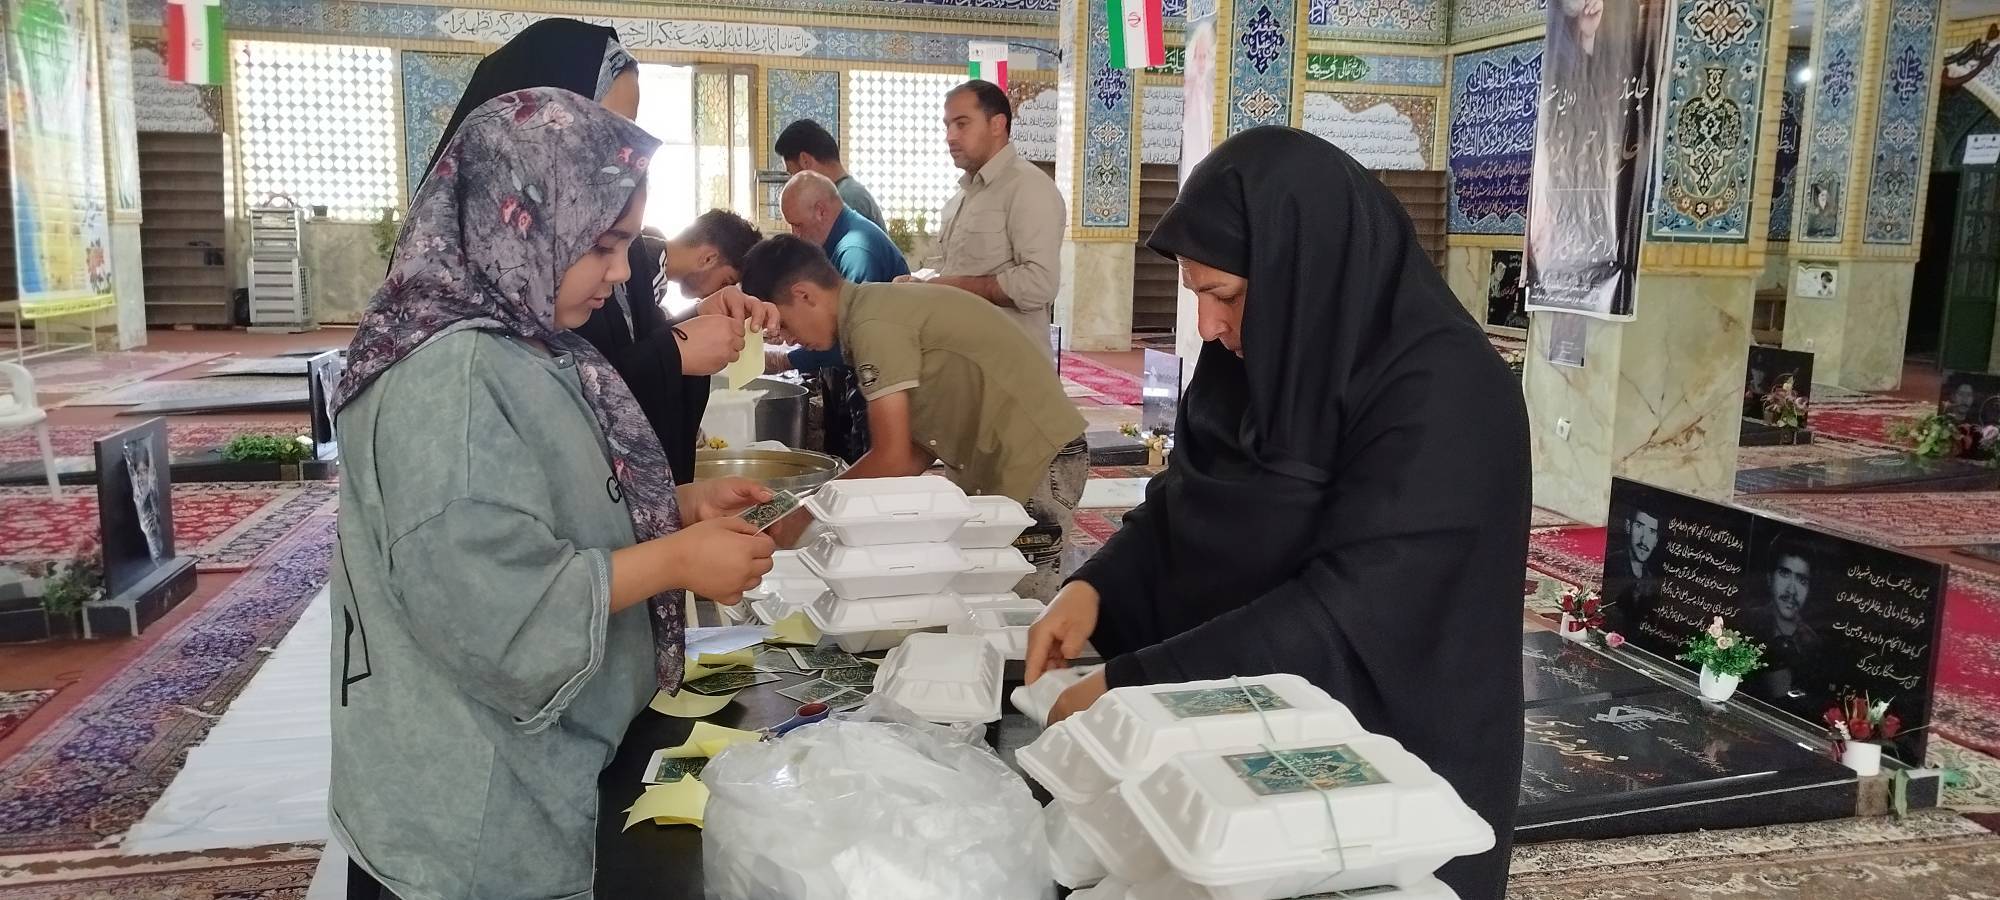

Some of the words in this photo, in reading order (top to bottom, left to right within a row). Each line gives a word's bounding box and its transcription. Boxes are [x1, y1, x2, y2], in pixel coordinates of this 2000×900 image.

[1617, 76, 1650, 117] جانباز
[1847, 565, 1871, 579] شهیدان
[1914, 586, 1930, 601] پس
[1856, 653, 1877, 675] بزرگ
[1871, 664, 1913, 686] رستگاری
[1904, 676, 1921, 690] آن
